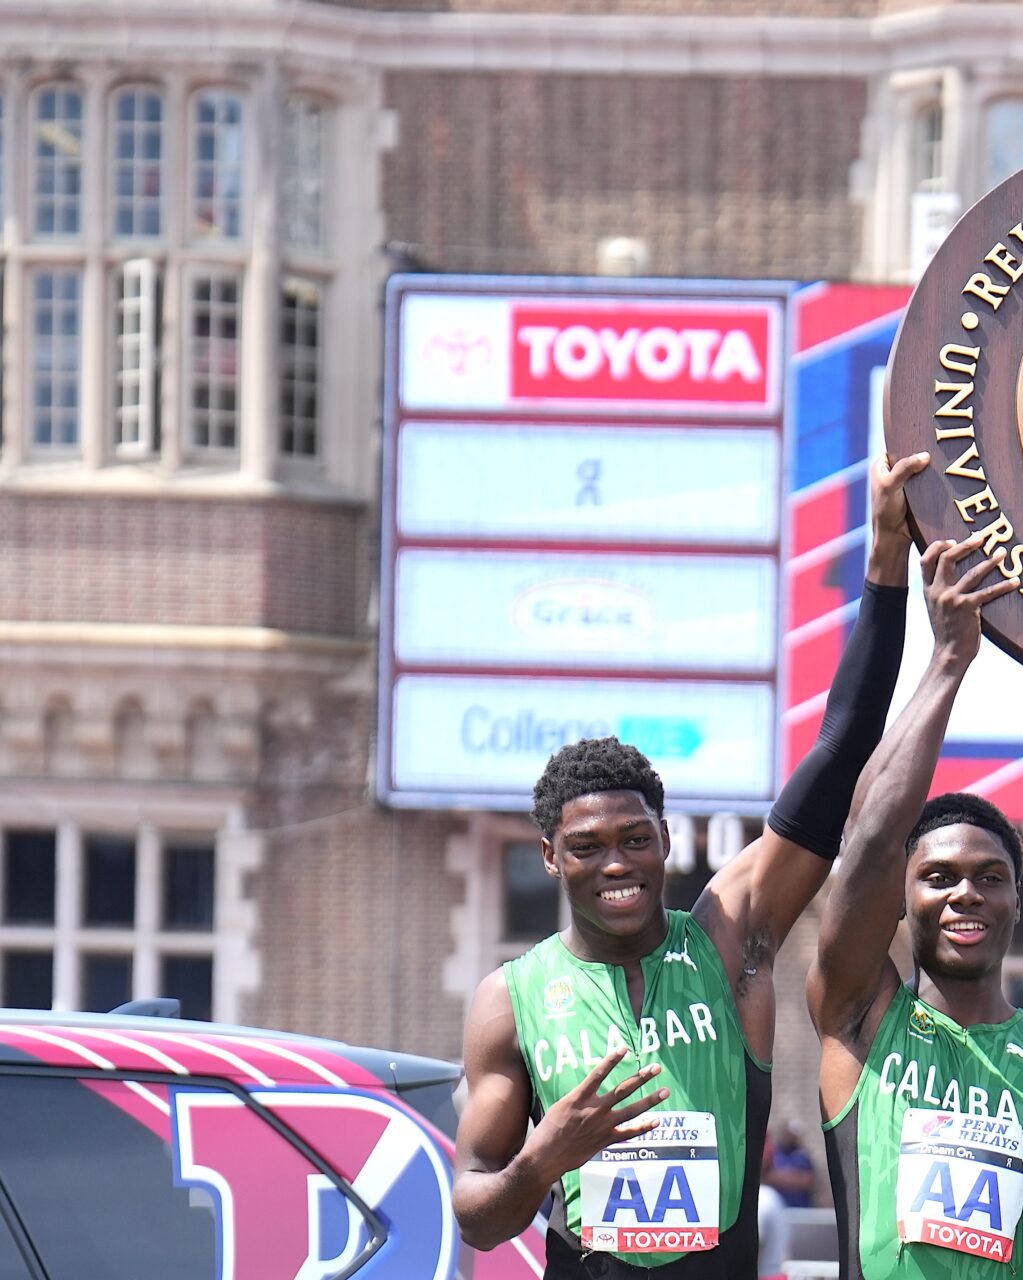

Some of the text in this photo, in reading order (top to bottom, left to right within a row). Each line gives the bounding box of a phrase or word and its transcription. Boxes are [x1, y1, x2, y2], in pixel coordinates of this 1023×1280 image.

[517, 324, 763, 383] TOYOTA
[534, 1002, 718, 1082] CALABAR
[958, 1129, 1020, 1151] RELAYS
[961, 1118, 1010, 1136] PENN
[602, 1148, 658, 1162] Dream On.
[919, 1143, 976, 1160] Dream On.
[601, 1165, 701, 1223] AA
[910, 1161, 1003, 1231] AA
[622, 1232, 706, 1248] TOYOTA
[927, 1222, 1004, 1258] TOYOTA
